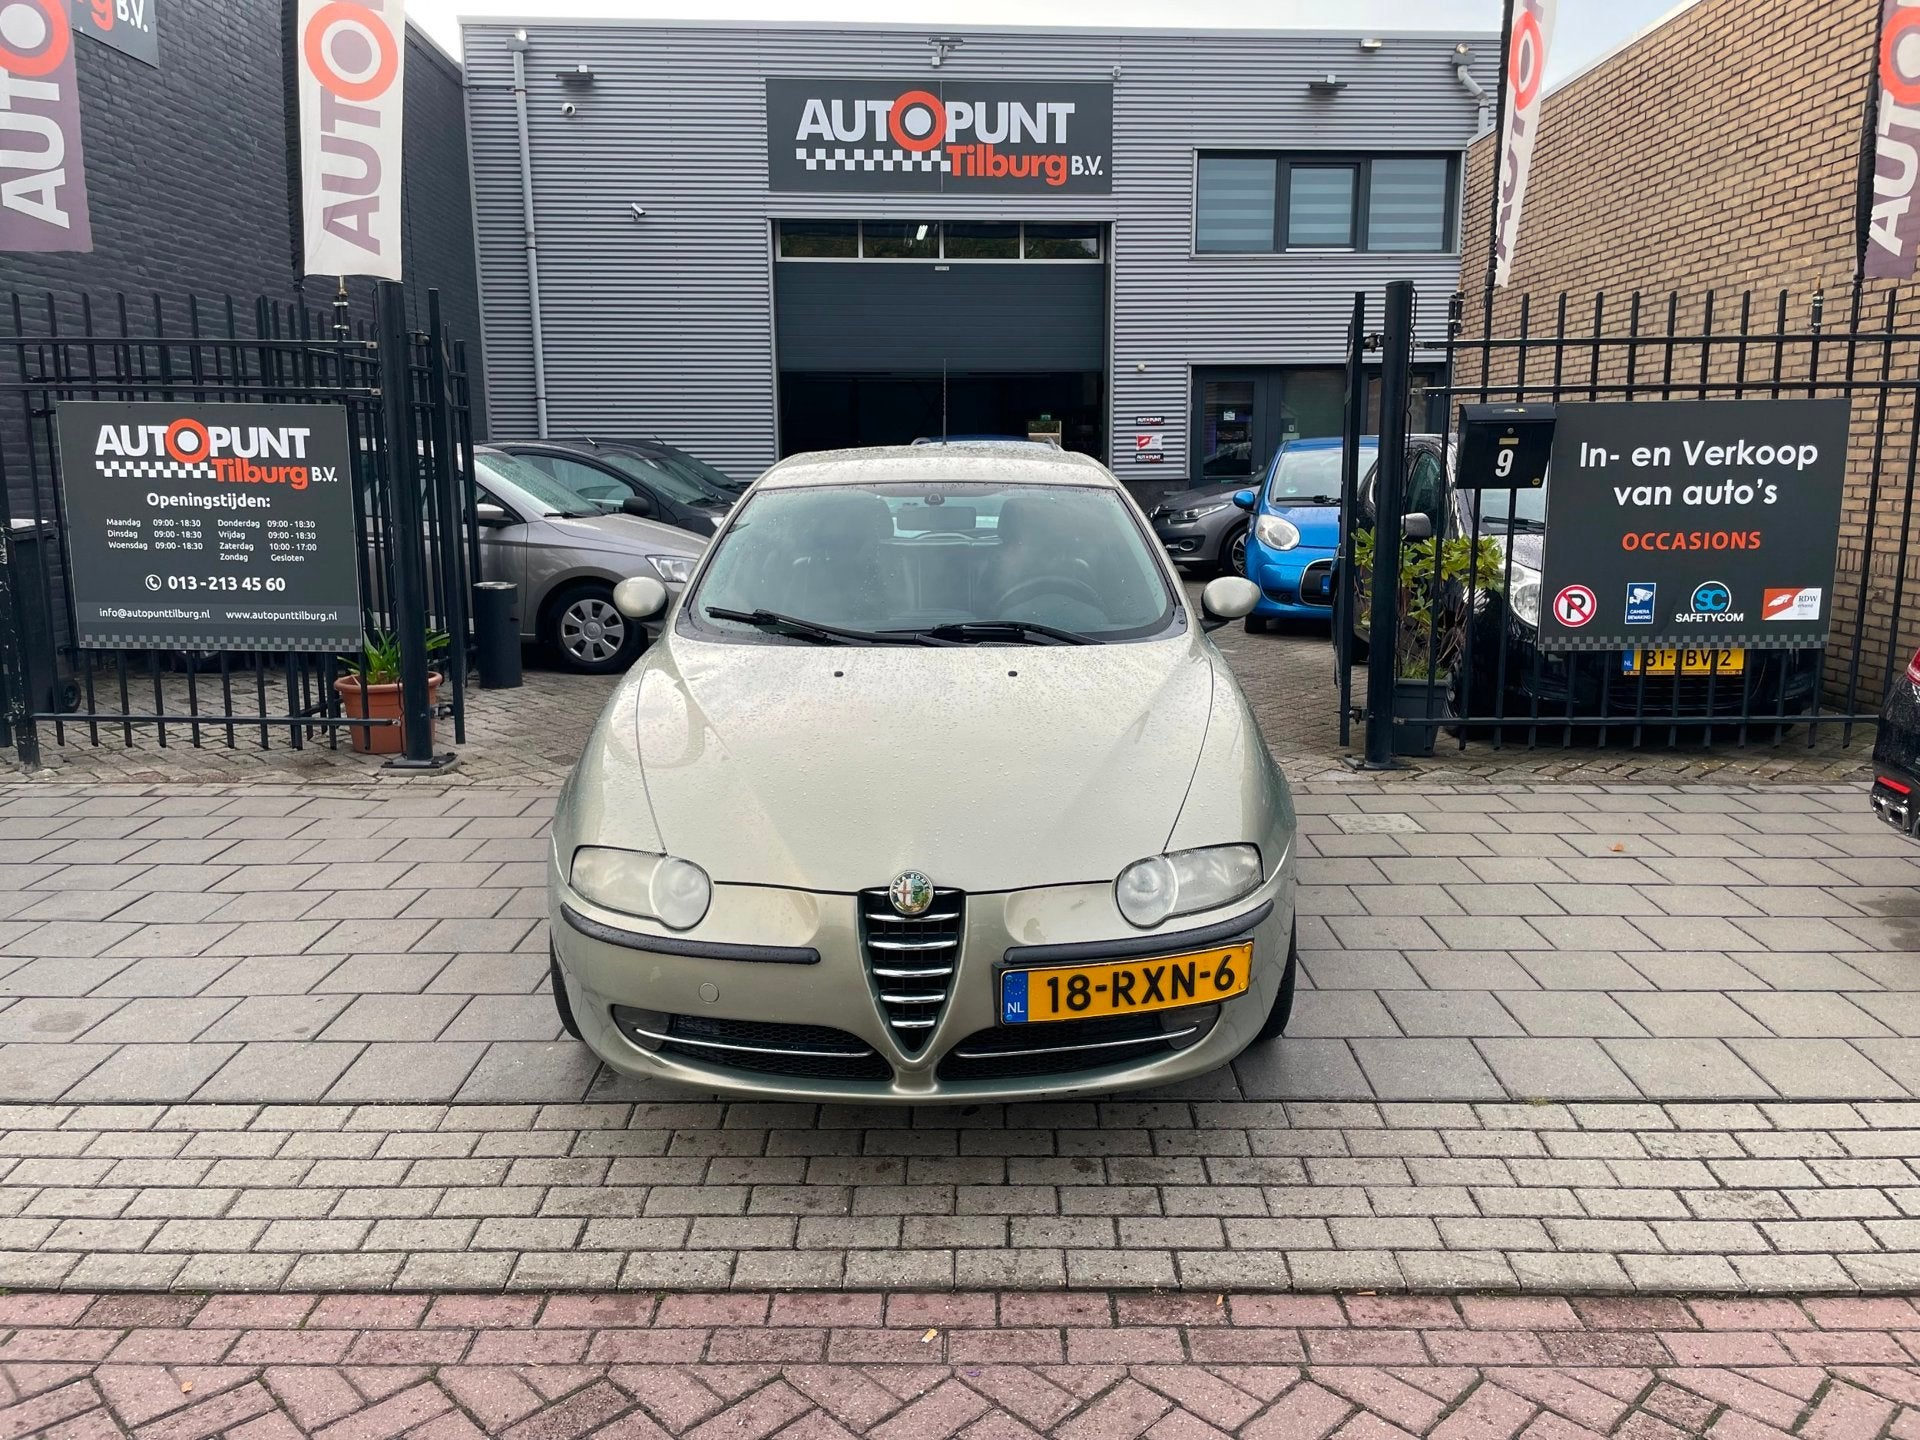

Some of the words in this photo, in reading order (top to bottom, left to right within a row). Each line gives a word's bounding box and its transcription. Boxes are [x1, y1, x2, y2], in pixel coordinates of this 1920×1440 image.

[304, 0, 398, 256] AUTO
[796, 90, 1076, 151] AUTOPUNT
[946, 145, 1067, 186] Tilburg
[1071, 155, 1103, 176] B.V.
[95, 418, 311, 464] AUTOPUNT
[1495, 449, 1514, 477] 9
[1580, 442, 1620, 468] In-
[1631, 446, 1671, 467] en
[1683, 439, 1818, 470] Verkoop
[212, 457, 308, 490] Tilburg
[311, 466, 338, 483] B.V.
[146, 492, 271, 509] Openingstijden:
[1613, 486, 1672, 506] van
[1682, 478, 1778, 505] auto's
[106, 518, 141, 528] Maandag
[153, 519, 174, 527] 09:00
[180, 519, 201, 527] 18:30
[217, 519, 260, 529] Donderdag
[267, 520, 288, 529] 09:00
[294, 520, 316, 529] 18:30
[107, 530, 138, 540] Dinsdag
[154, 530, 175, 539] 09:00
[181, 530, 202, 539] 18:30
[218, 531, 246, 541] Vrijdag
[268, 531, 290, 540] 09:00
[295, 532, 317, 540] 18:30
[1622, 531, 1761, 551] OCCASIONS
[108, 541, 148, 551] Woensdag
[155, 541, 176, 550] 09:00
[182, 541, 203, 550] 18:30
[219, 542, 254, 552] Zaterdag
[269, 543, 290, 551] 10:00
[297, 543, 317, 551] 17:00
[220, 553, 249, 563] Zondag
[270, 553, 305, 563] Gesloten
[241, 577, 262, 592] 45
[265, 577, 286, 592] 60
[99, 608, 211, 619] info@autopunttilburg.nl
[225, 611, 338, 621] www.autopunttilburg.nl
[1675, 613, 1744, 622] SAFETYCOM
[1646, 649, 1731, 667] 81-BV2
[1047, 954, 1236, 1014] 18-RXN-6
[1007, 1001, 1025, 1013] NL
